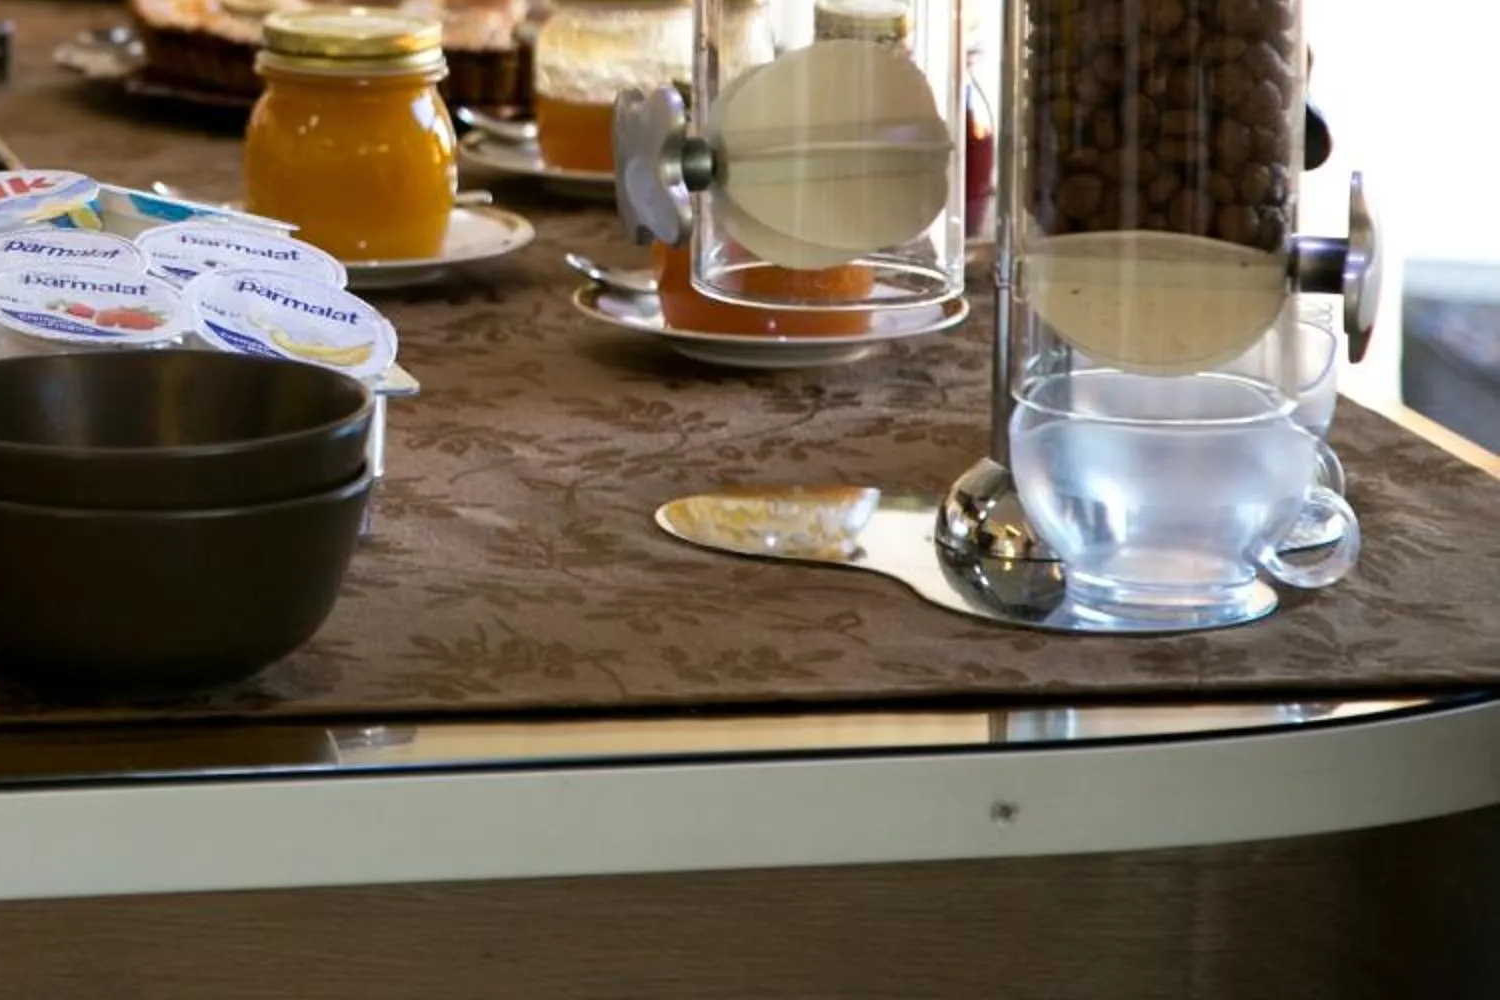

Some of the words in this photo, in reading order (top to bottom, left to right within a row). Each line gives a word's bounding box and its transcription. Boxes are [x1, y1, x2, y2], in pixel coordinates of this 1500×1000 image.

[3, 238, 121, 260] parmalat
[23, 272, 149, 296] parmalat
[236, 279, 361, 326] parmalat
